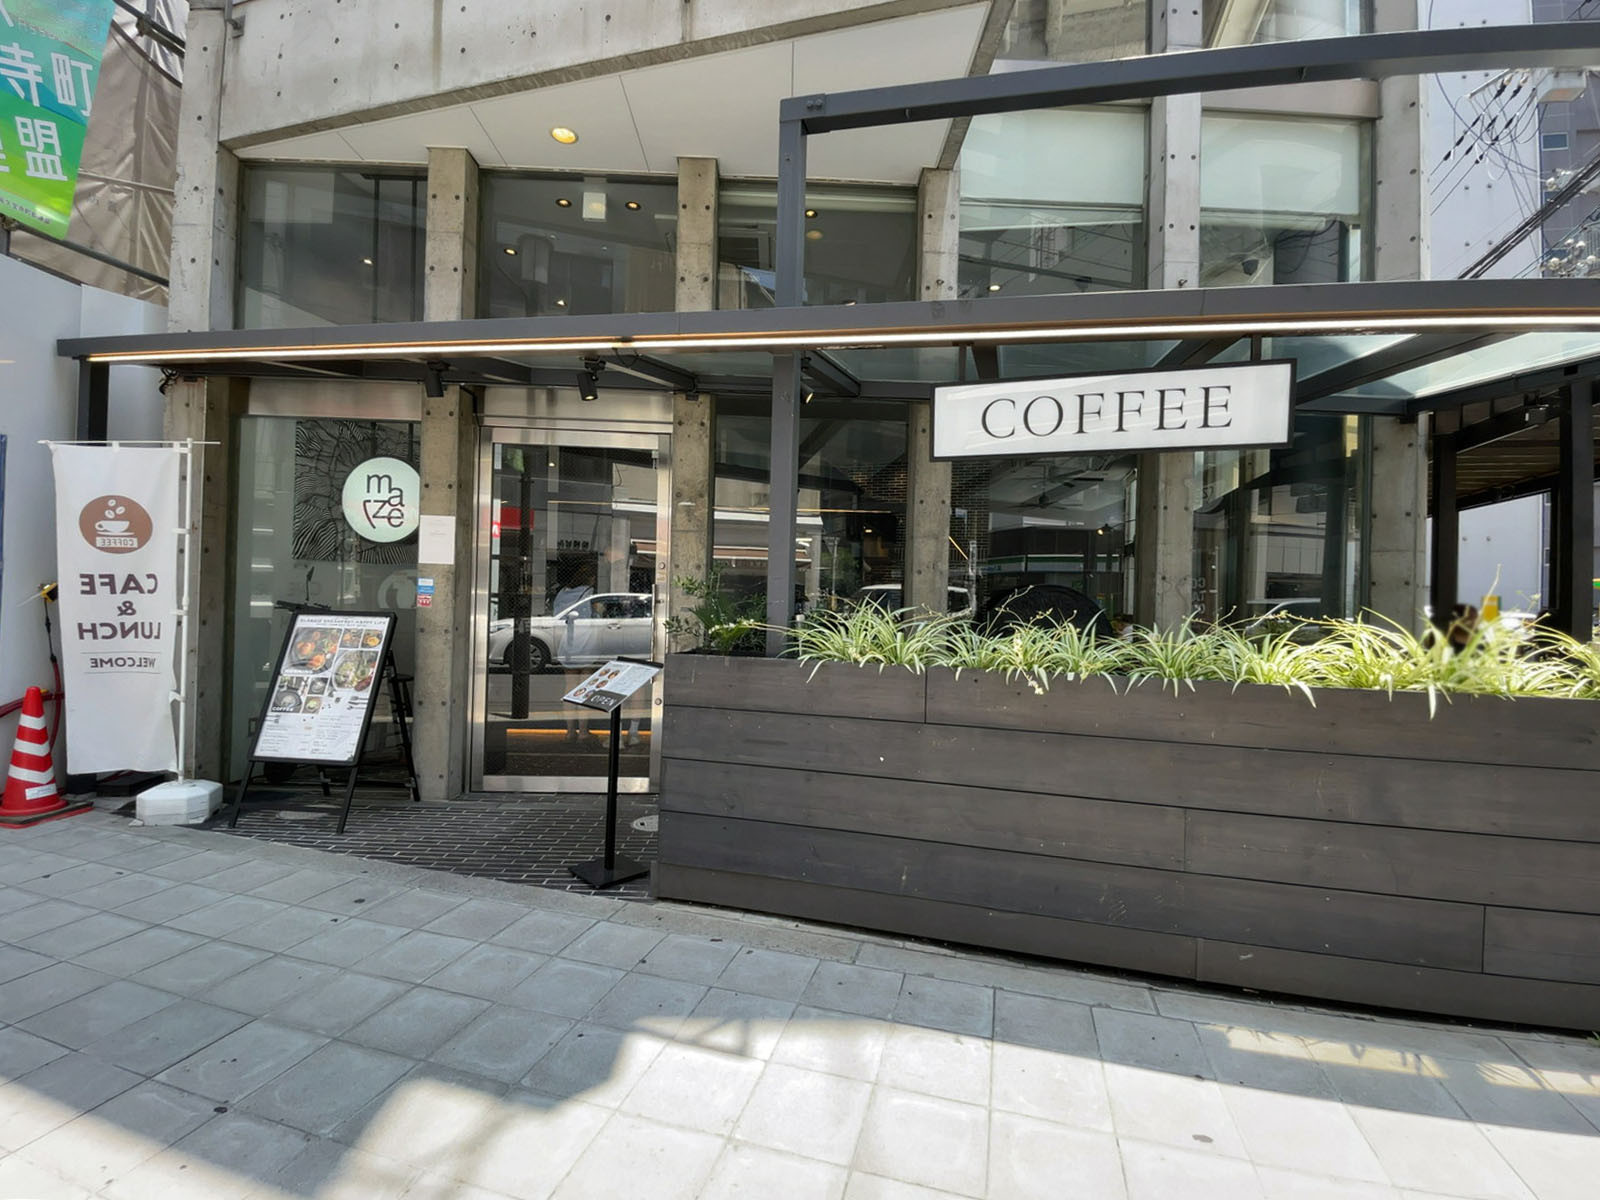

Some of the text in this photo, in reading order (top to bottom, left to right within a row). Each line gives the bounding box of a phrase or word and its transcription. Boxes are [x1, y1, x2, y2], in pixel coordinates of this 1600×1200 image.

[0, 42, 93, 117] 寺町
[0, 116, 68, 181] 盟
[981, 385, 1233, 439] COFFEE
